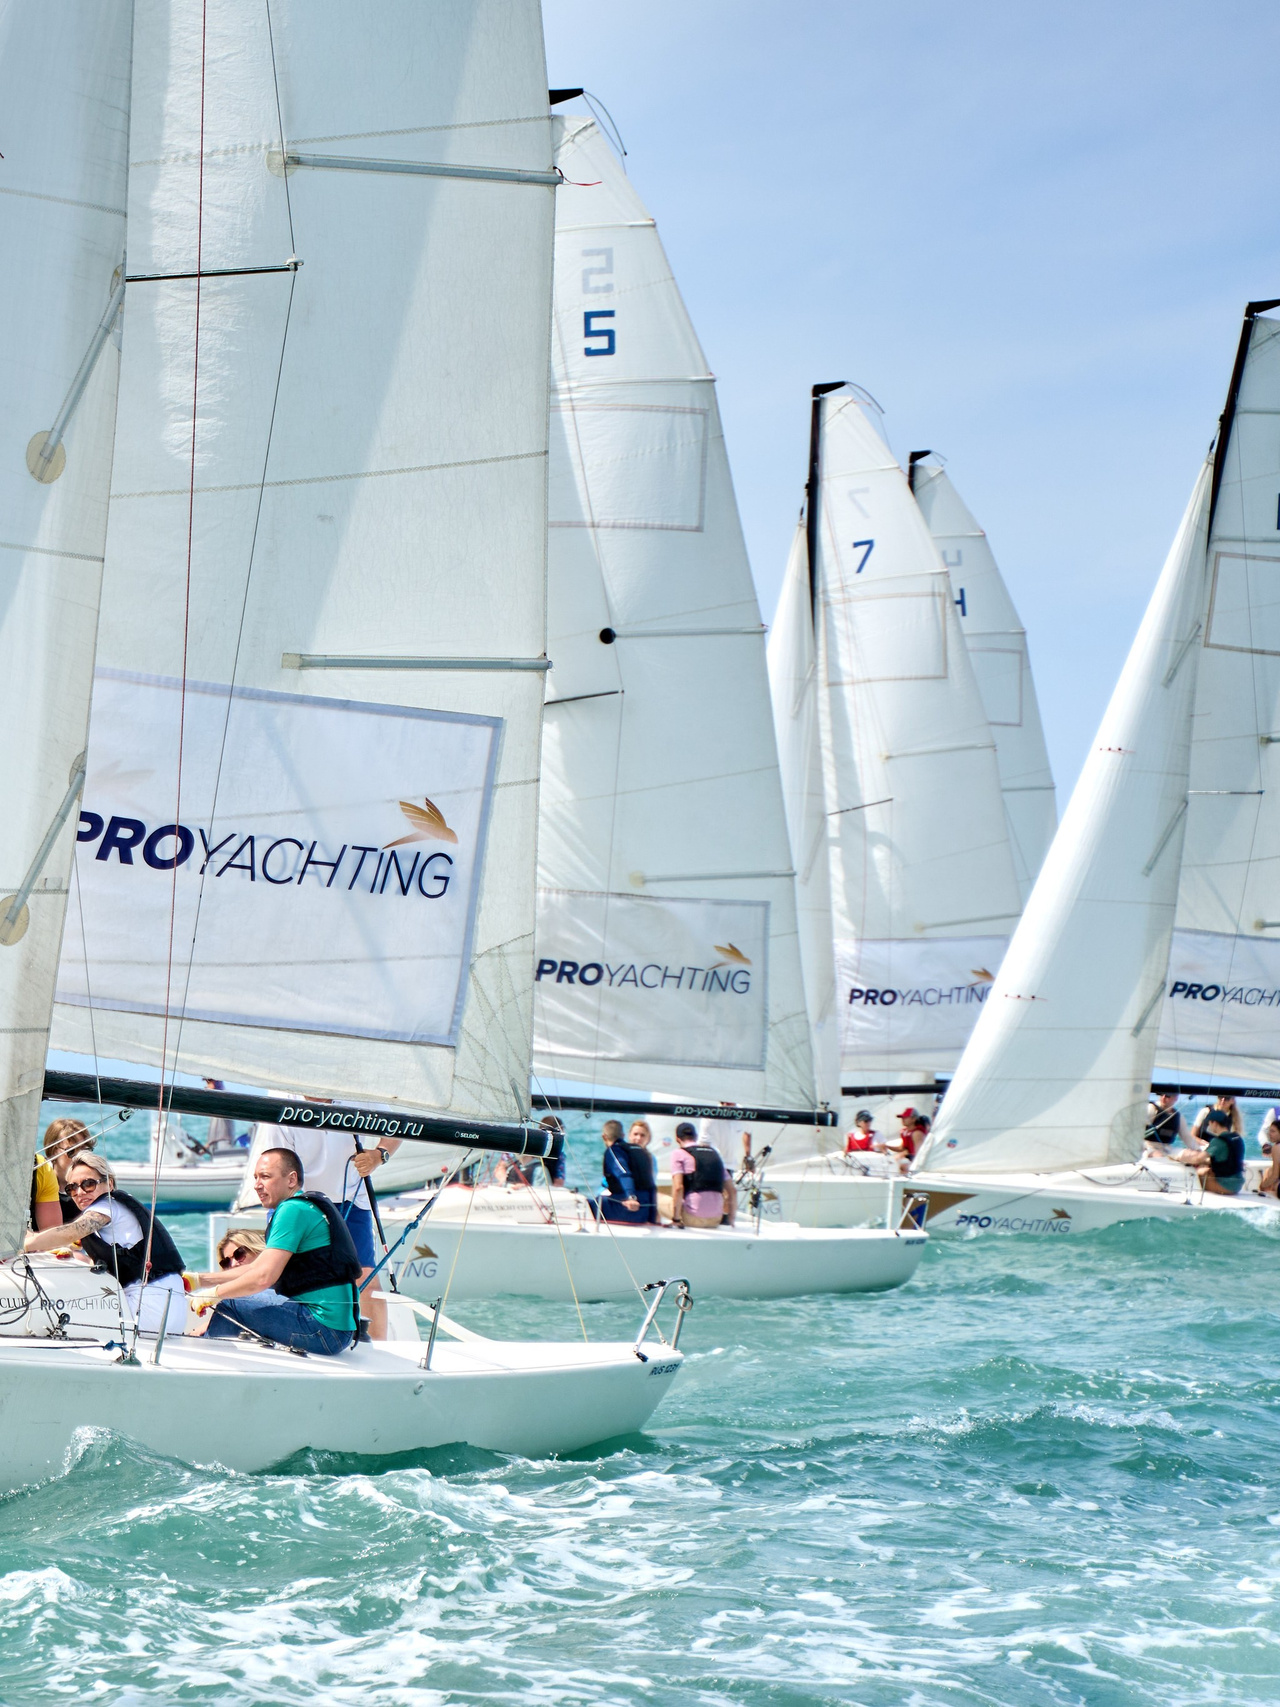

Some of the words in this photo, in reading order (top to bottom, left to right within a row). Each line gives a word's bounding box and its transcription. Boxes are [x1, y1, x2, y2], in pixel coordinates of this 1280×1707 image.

[584, 310, 616, 356] 5
[853, 539, 874, 573] 7
[76, 811, 453, 899] PROYACHTING
[535, 959, 751, 994] PROYACHTING
[278, 1105, 424, 1137] pro-yachting.ru
[674, 1105, 757, 1119] pro-yachting.ru
[0, 1297, 28, 1309] CLUB
